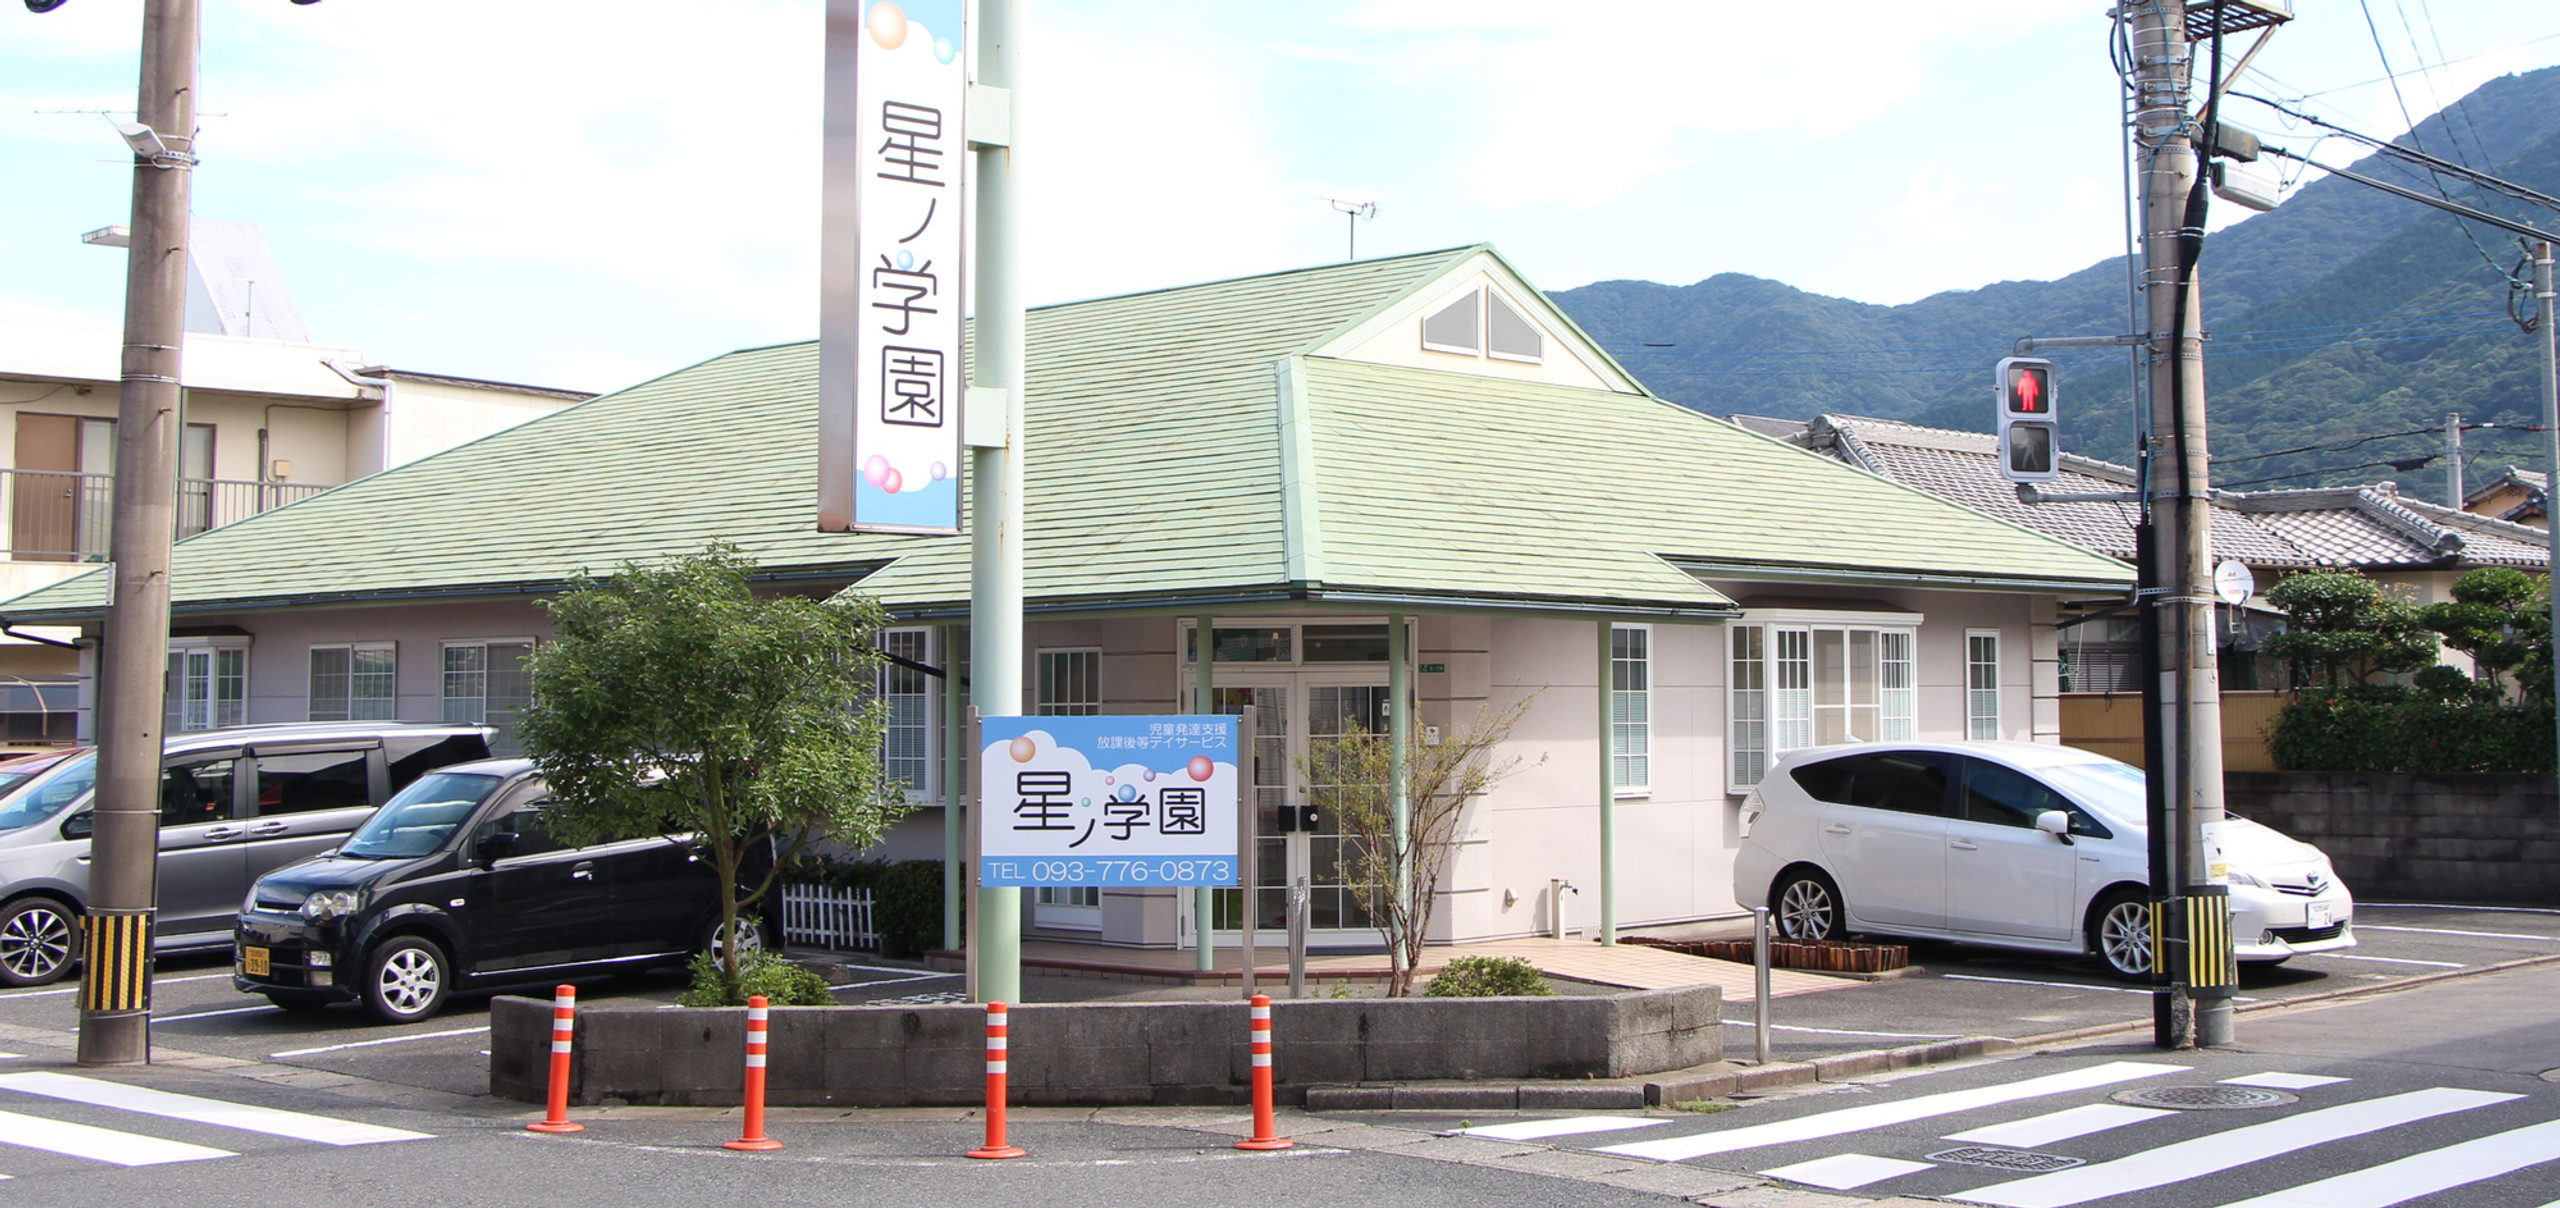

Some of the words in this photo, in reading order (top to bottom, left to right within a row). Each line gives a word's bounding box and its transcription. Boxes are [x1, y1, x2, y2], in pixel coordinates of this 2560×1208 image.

[872, 100, 946, 428] 星ノ学園
[1149, 723, 1227, 736] 児童発達支援
[1097, 736, 1228, 749] 放課後等デイサービス
[1013, 771, 1205, 848] 星ノ学園
[988, 862, 1025, 879] TEL
[1032, 860, 1229, 882] 093-776-0873
